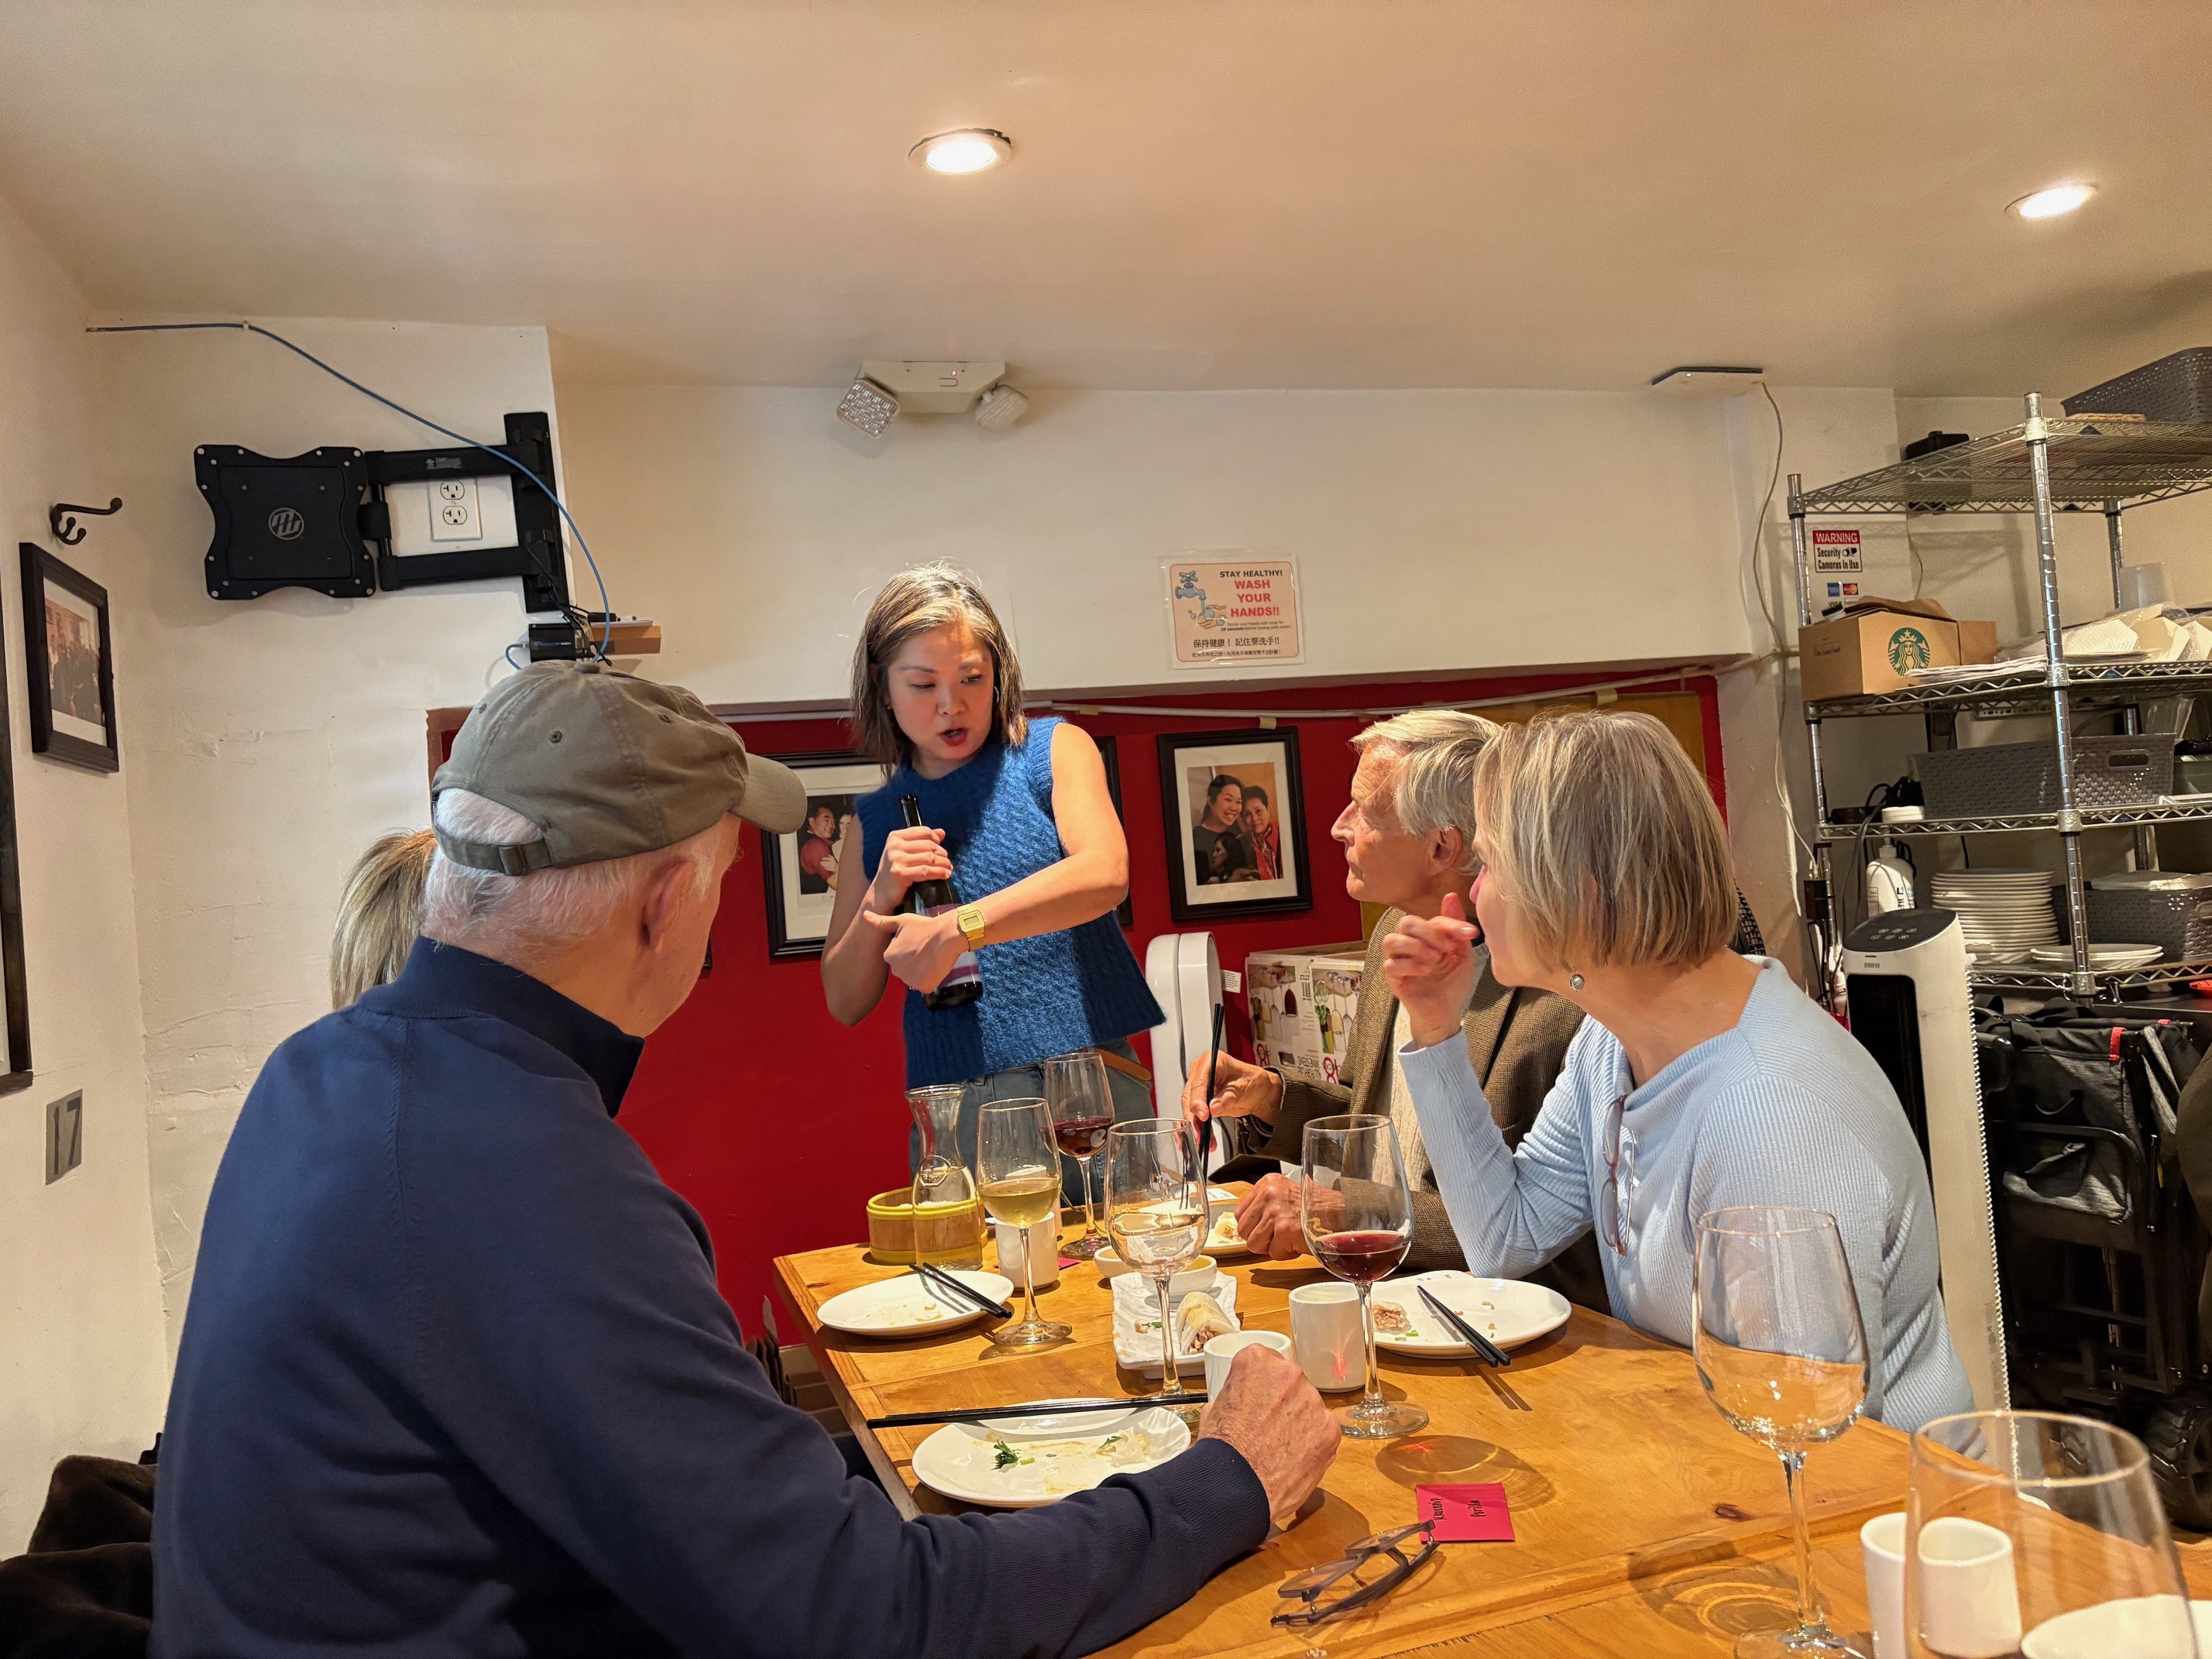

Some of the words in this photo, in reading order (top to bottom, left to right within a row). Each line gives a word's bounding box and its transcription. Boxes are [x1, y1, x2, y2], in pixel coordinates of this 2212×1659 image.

[1815, 532, 1858, 543] WARNING
[1817, 547, 1841, 560] Security
[1818, 559, 1842, 570] Cameras
[1843, 559, 1848, 569] In
[1849, 559, 1860, 569] Use
[1235, 579, 1271, 589] WASH
[1237, 593, 1272, 603] YOUR
[1230, 606, 1279, 617] HANDS!!
[53, 1096, 82, 1176] 17
